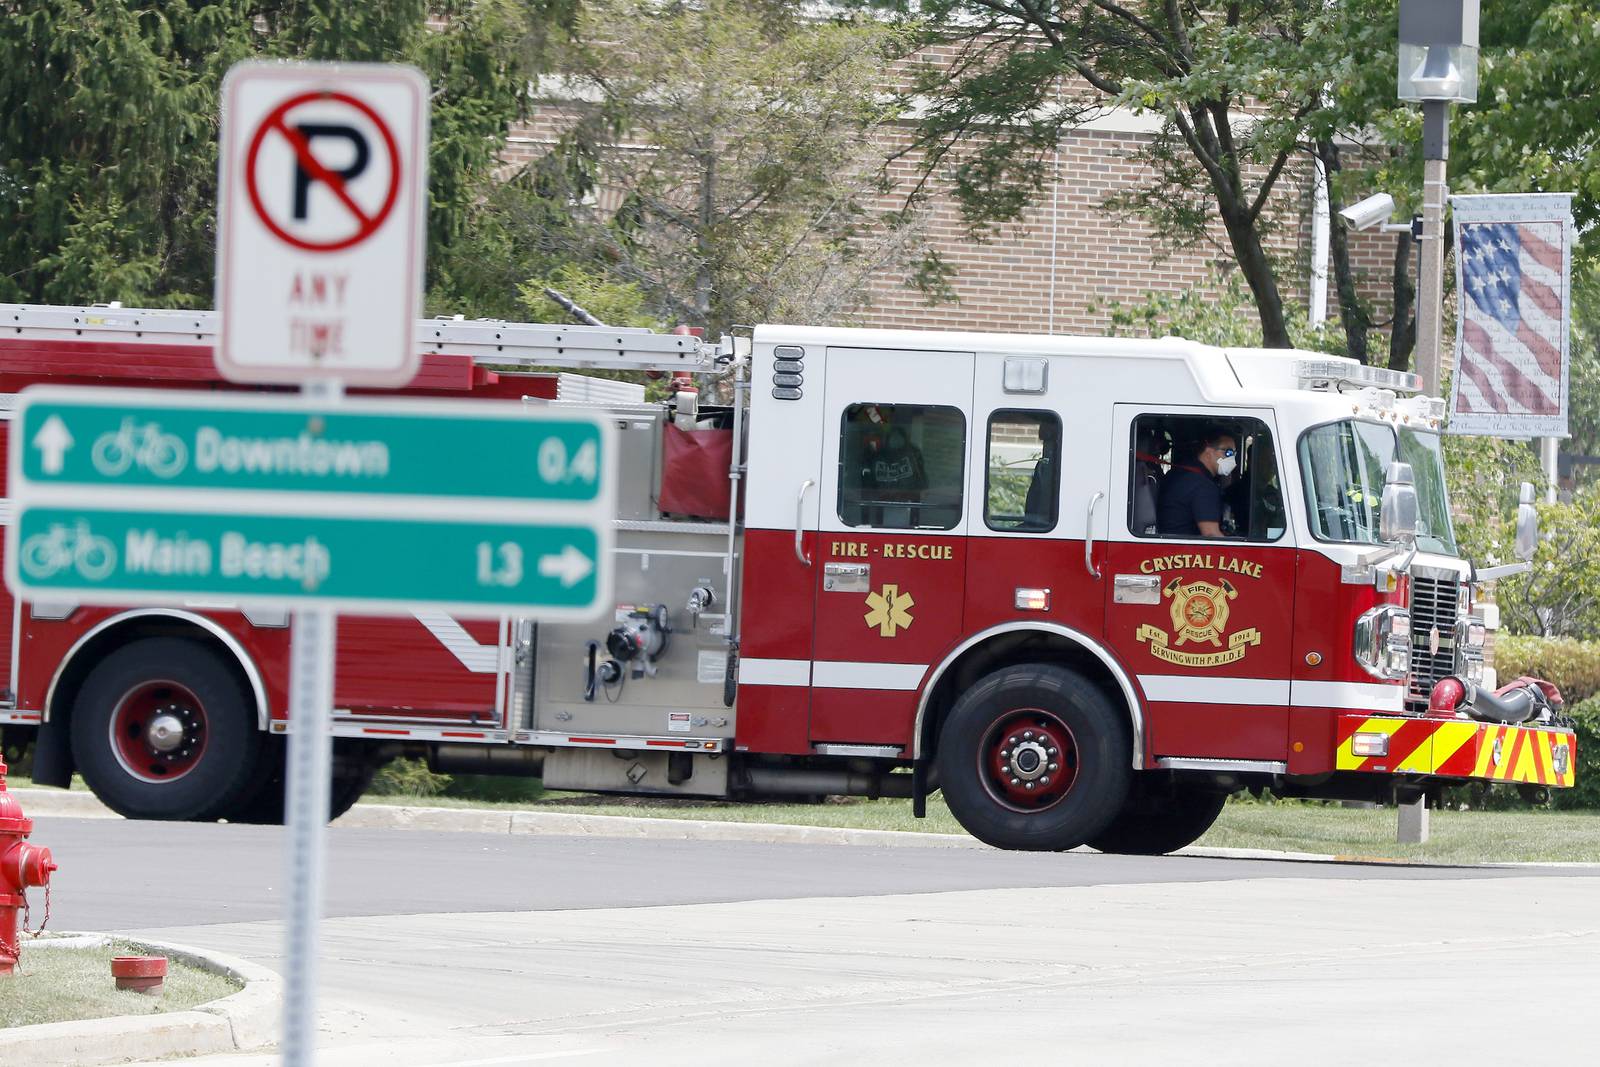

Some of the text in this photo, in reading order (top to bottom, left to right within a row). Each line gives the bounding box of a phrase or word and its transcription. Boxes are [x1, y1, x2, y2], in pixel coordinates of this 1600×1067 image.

[291, 273, 348, 303] ANY
[290, 318, 344, 353] TIME
[195, 426, 598, 485] Downtown 0.4
[124, 527, 524, 587] Main Beach 1.3
[831, 542, 868, 557] FIRE
[883, 543, 953, 560] RESCUE
[1140, 554, 1263, 578] CRYSTAL LAKE
[1187, 585, 1214, 595] FIRE
[1185, 628, 1213, 637] RESCUE
[1233, 632, 1251, 643] 1914
[1152, 645, 1245, 665] SERVING WITH P.R.I.D.E.
